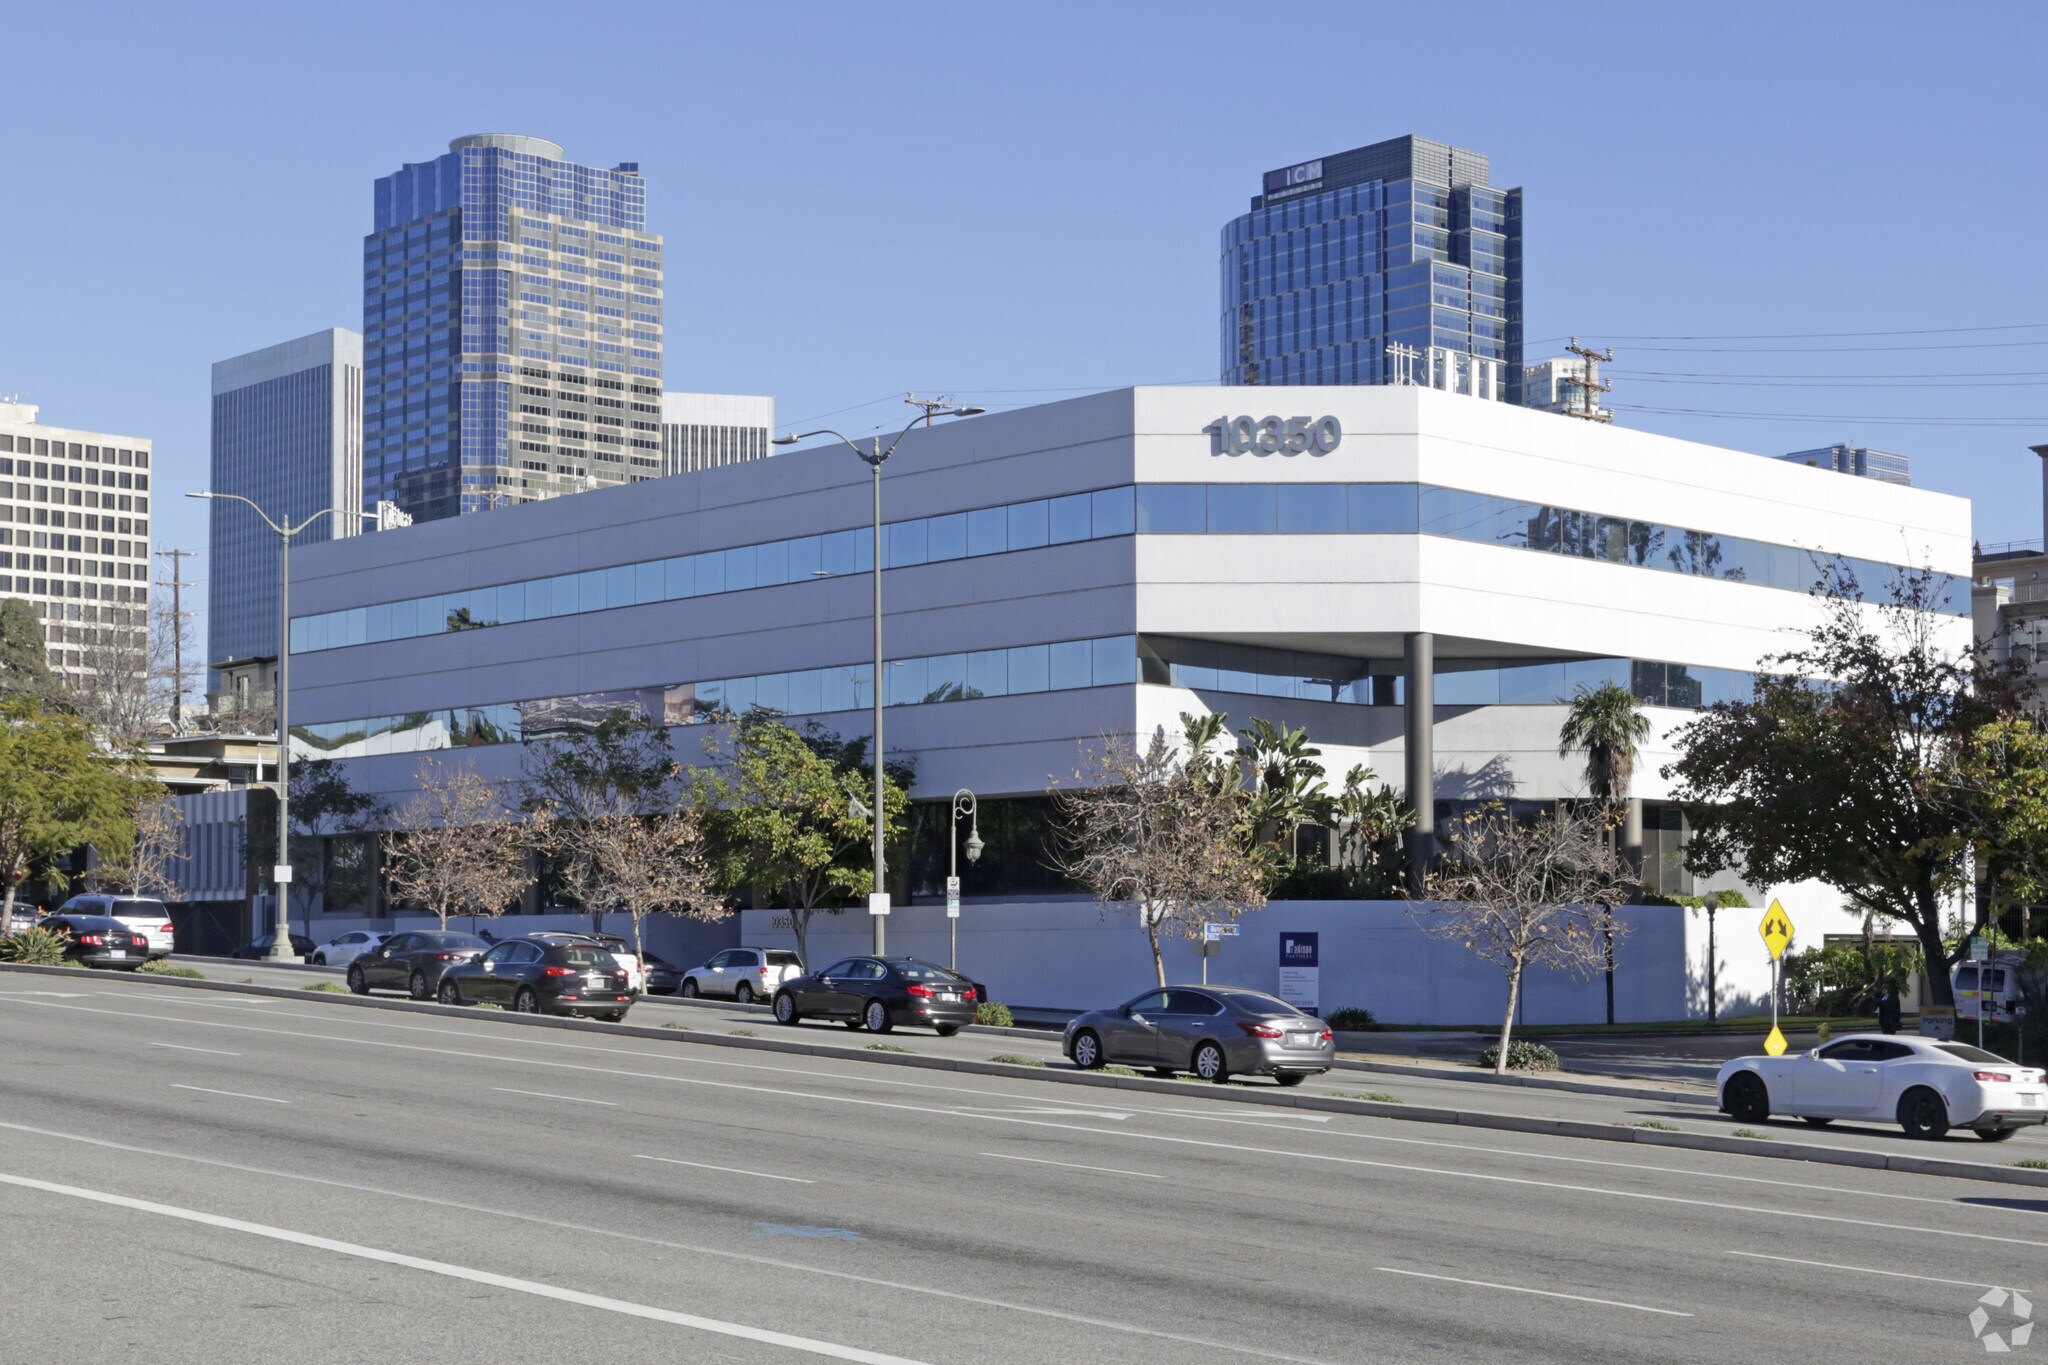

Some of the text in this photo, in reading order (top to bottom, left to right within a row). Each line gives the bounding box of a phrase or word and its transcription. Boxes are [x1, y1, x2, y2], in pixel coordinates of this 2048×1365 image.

[1287, 161, 1321, 186] ICM
[1206, 415, 1342, 456] 10350
[1923, 1016, 1953, 1025] Parking
